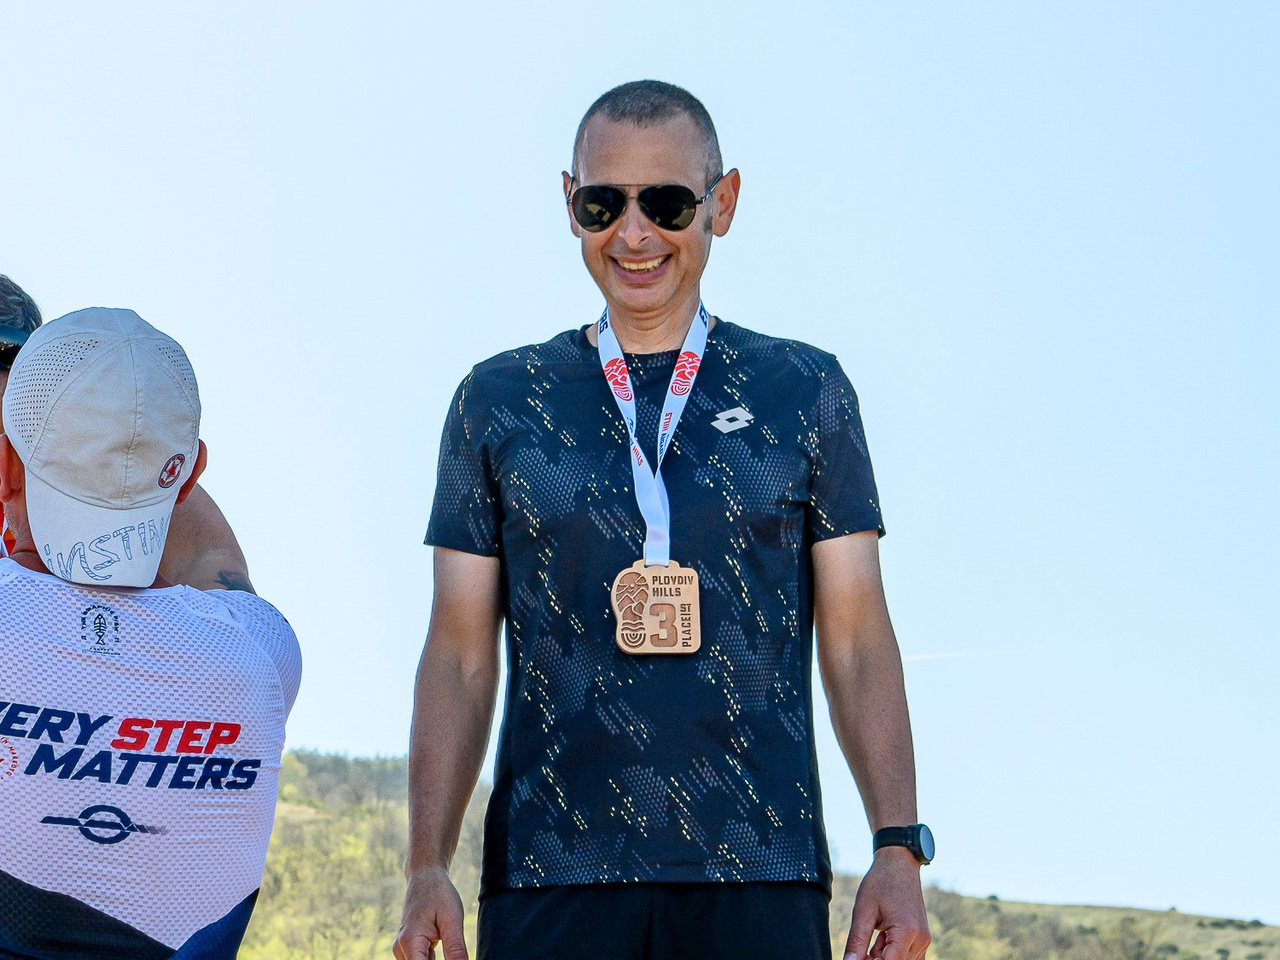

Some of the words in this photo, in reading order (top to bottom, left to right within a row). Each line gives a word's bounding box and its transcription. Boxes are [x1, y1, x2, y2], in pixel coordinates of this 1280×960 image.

[651, 575, 694, 586] PLOVDIV
[652, 587, 681, 597] HILLS
[649, 602, 679, 647] 3
[111, 717, 241, 754] STEP
[23, 743, 262, 790] MATTERS
